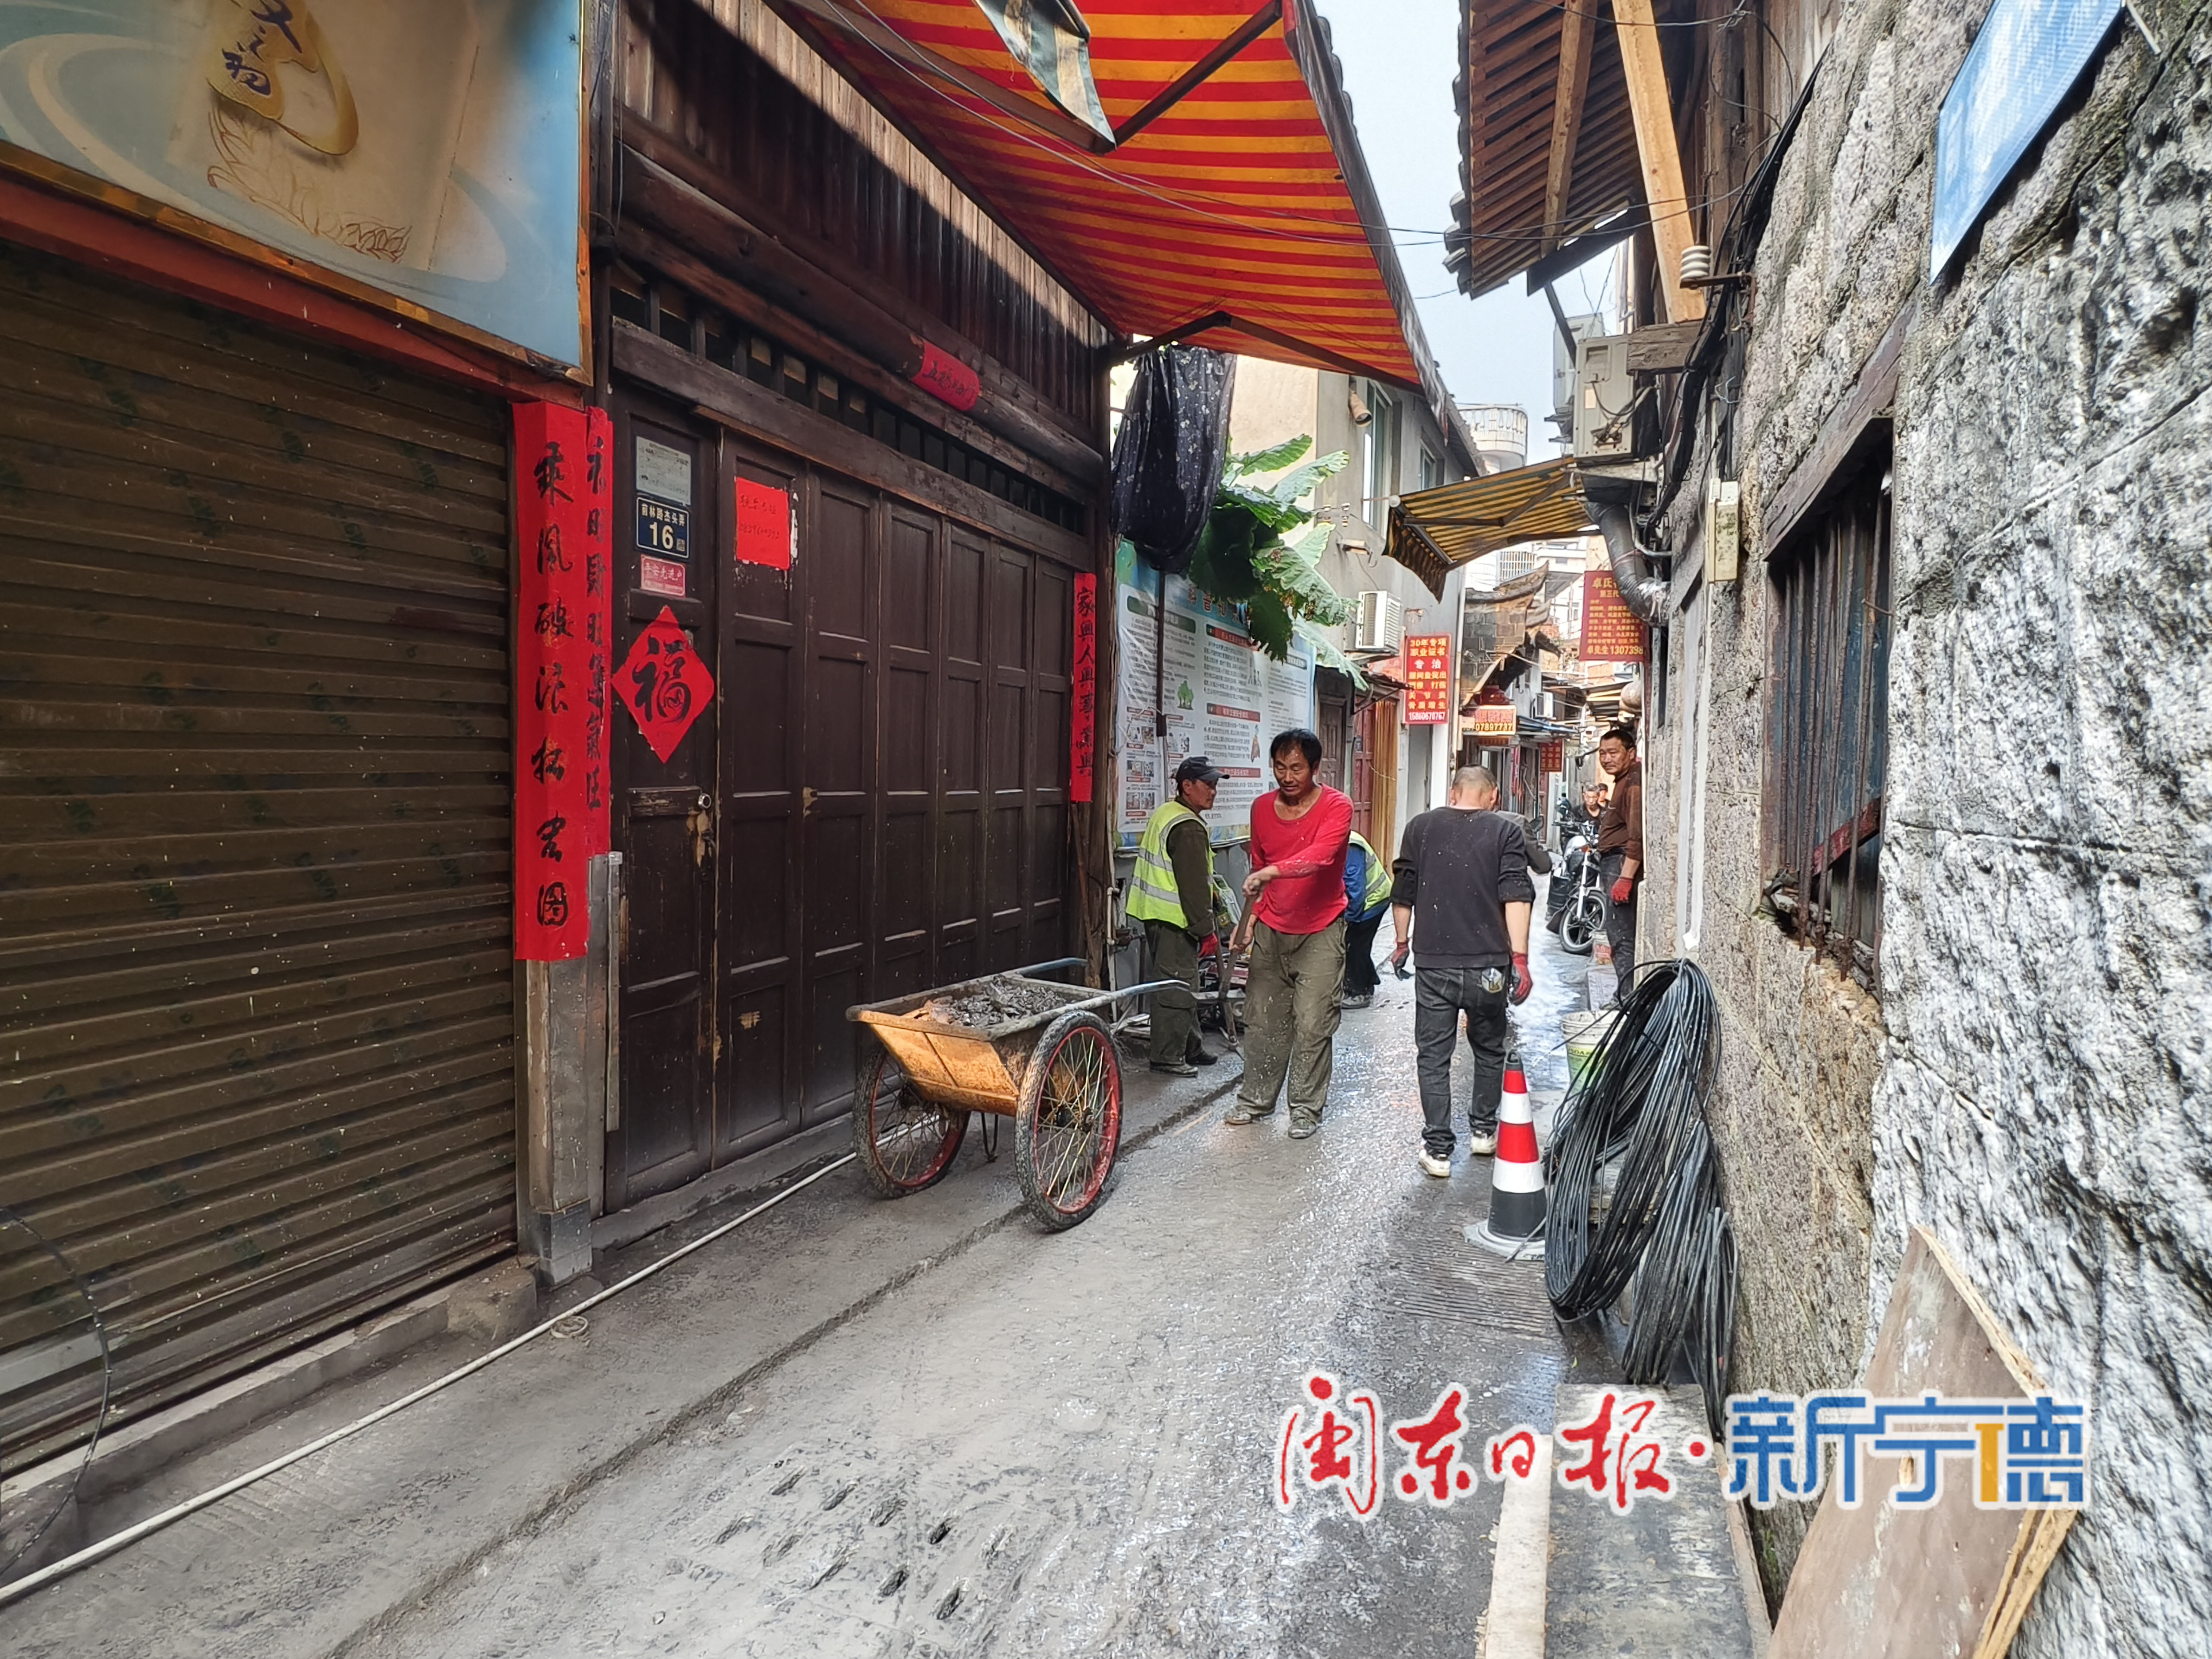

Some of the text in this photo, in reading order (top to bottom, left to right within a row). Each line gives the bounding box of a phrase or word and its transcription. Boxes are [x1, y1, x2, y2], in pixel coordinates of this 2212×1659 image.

[650, 522, 674, 550] 16
[1410, 647, 1445, 657] 职业证书
[632, 633, 691, 724] 福
